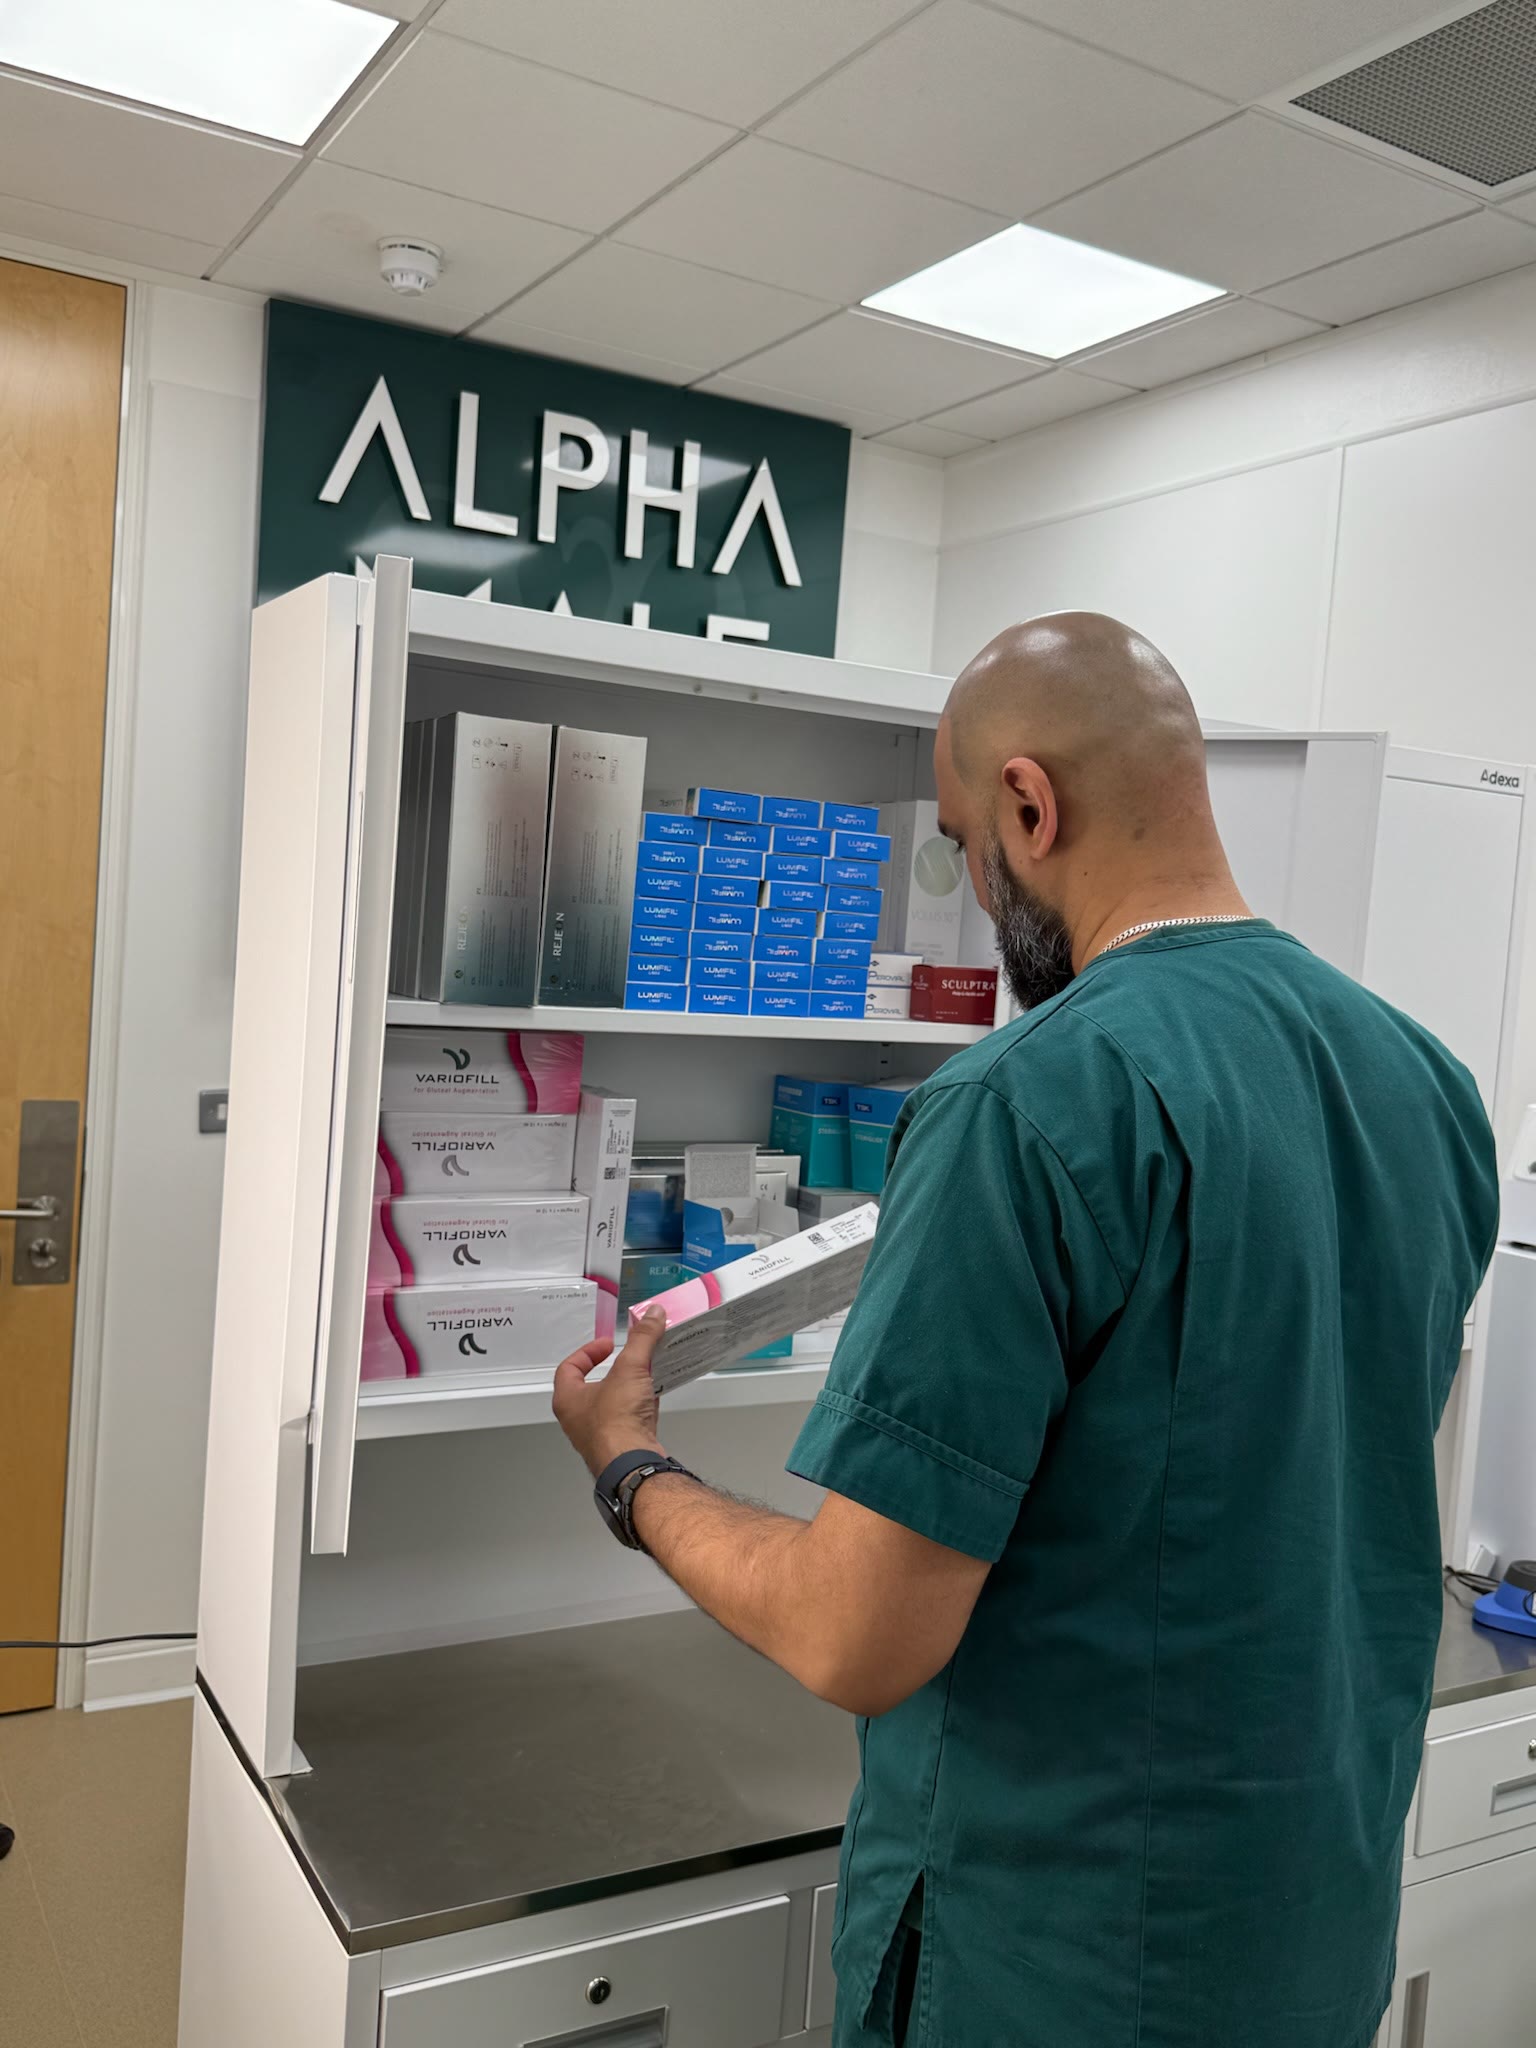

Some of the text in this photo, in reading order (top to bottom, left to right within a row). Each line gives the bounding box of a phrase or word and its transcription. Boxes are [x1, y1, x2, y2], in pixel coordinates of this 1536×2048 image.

[318, 375, 802, 587] ALPHA
[1480, 769, 1519, 788] Adexa
[941, 979, 996, 991] SCULPTRA
[416, 1074, 499, 1084] VARIOFILL
[427, 1086, 451, 1094] Gluteal
[453, 1087, 499, 1095] Augmentation
[412, 1130, 459, 1138] Augmentation
[412, 1142, 495, 1151] VARIOFILL
[423, 1219, 470, 1227] Augmentation
[423, 1229, 507, 1241] VARIOFILL
[748, 1255, 791, 1277] VARIOFILL
[427, 1307, 475, 1317] Augmentation
[478, 1306, 502, 1314] Gluteal
[427, 1317, 513, 1331] VARIOFILL
